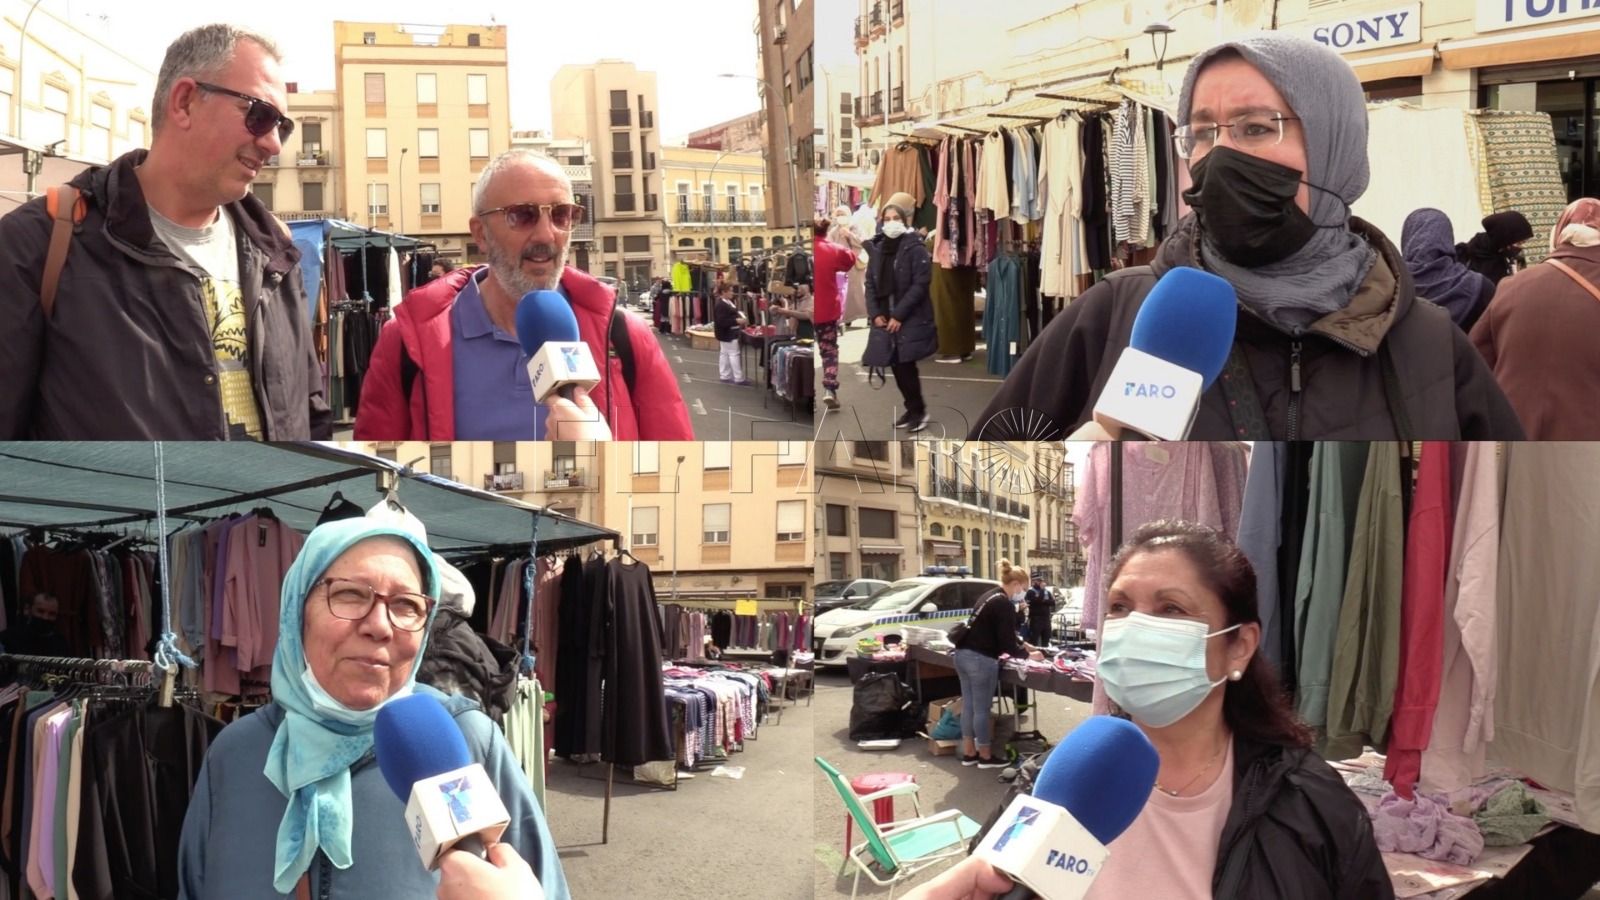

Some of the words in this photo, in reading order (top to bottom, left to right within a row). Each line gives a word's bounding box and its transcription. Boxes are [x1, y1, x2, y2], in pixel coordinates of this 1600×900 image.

[1313, 11, 1409, 48] SONY
[1124, 382, 1176, 399] FARO
[1046, 849, 1088, 874] FARO
